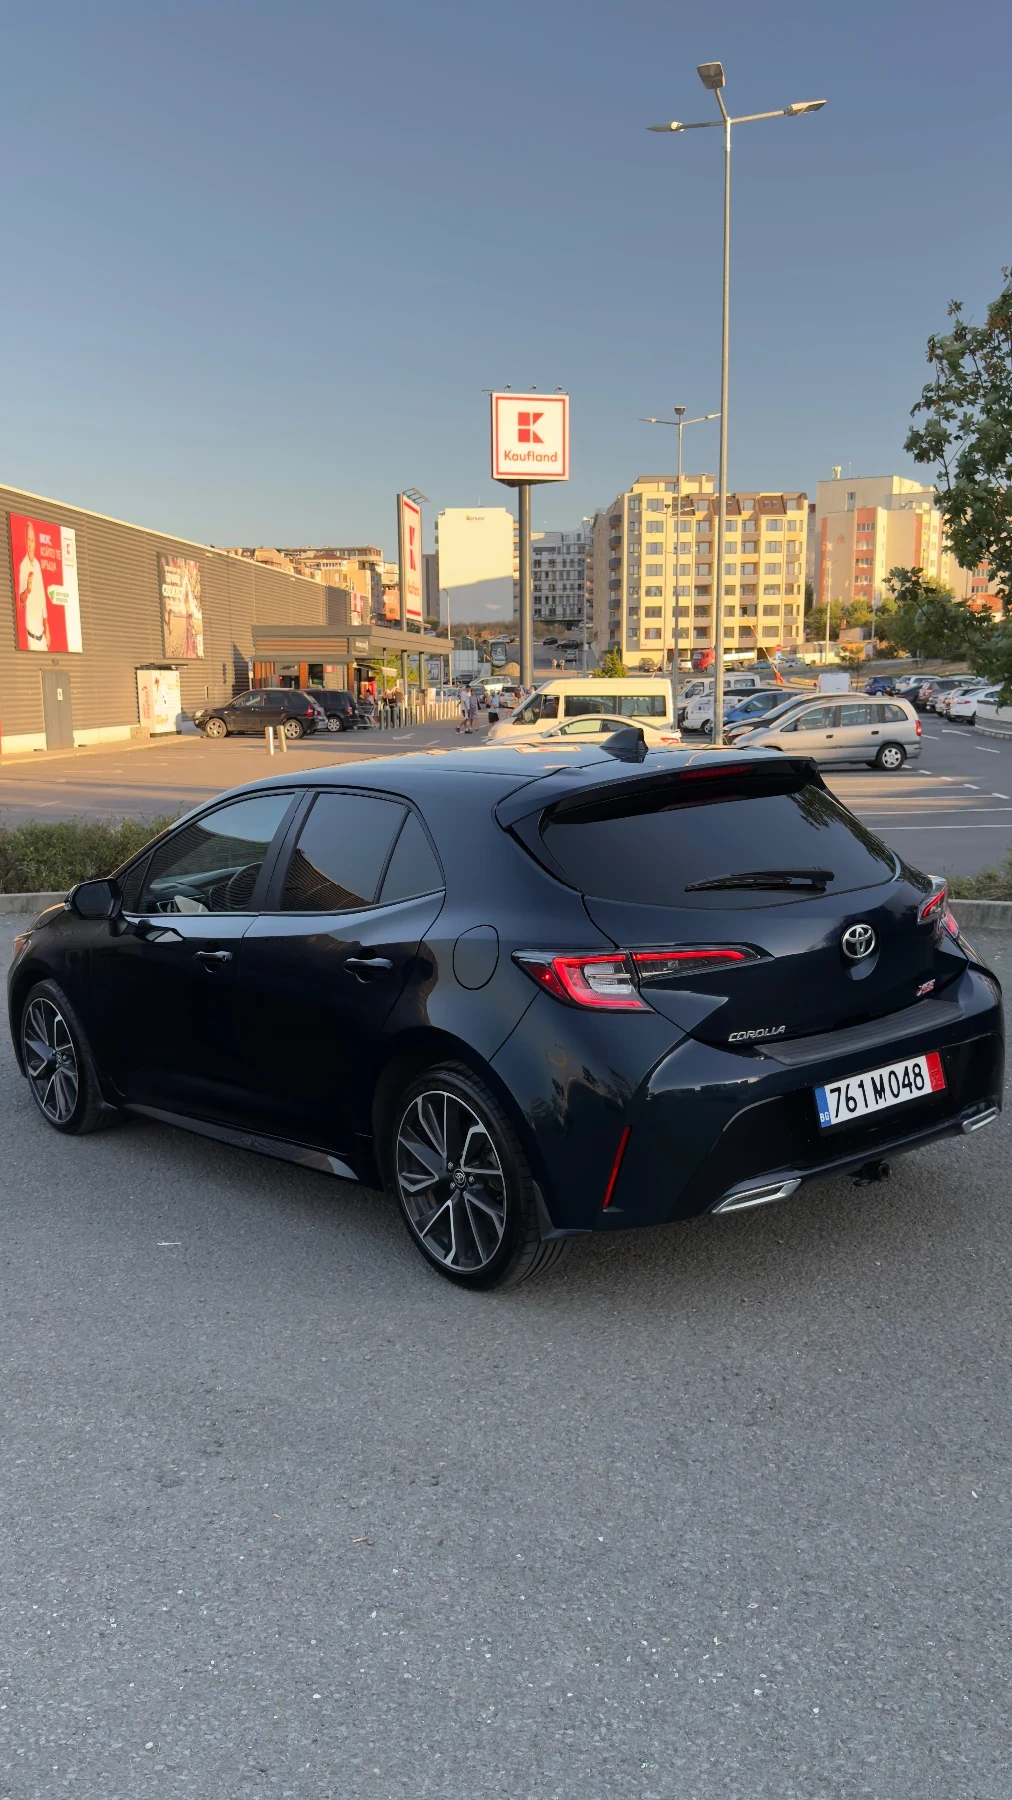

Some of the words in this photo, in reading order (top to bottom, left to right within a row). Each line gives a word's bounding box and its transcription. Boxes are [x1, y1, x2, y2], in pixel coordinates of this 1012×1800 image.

[504, 449, 558, 463] Kaufland
[728, 1025, 786, 1042] COROLLA
[819, 1111, 830, 1123] BG
